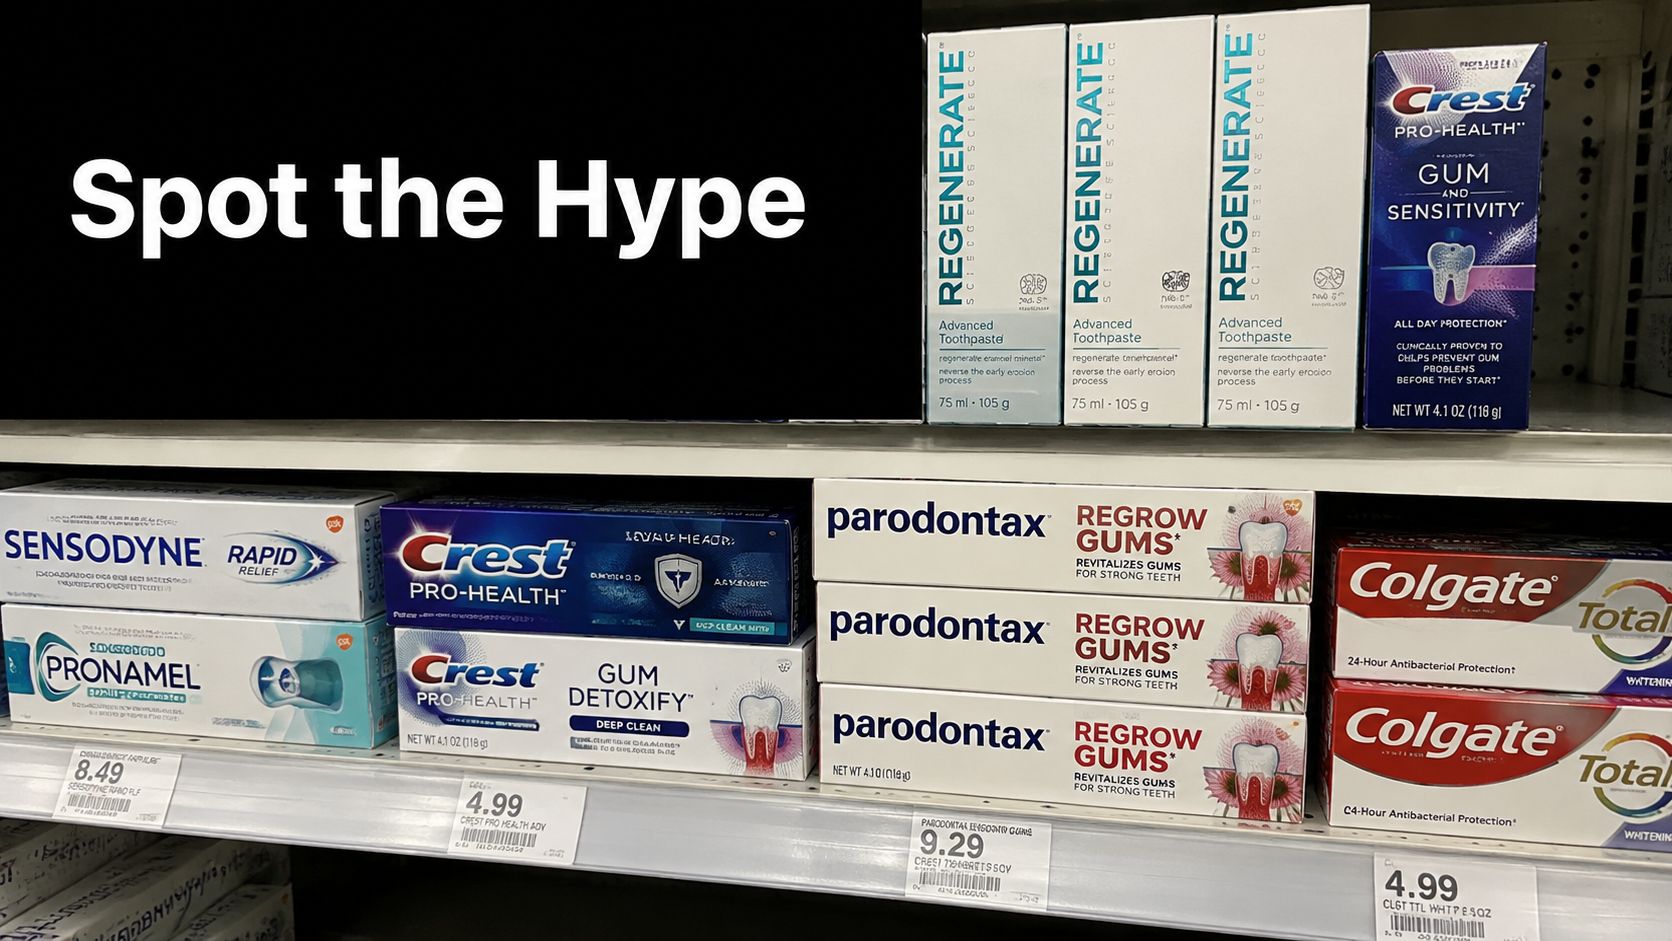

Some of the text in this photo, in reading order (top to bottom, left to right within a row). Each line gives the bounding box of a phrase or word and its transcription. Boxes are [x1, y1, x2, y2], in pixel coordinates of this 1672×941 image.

[1392, 83, 1530, 115] Crest
[1395, 122, 1516, 138] PRO-HEALTH
[1074, 42, 1103, 303] REGENERATE
[1219, 33, 1253, 301] REGENERATE
[1419, 162, 1489, 185] GUM
[939, 51, 964, 305] REGENERATE
[1442, 189, 1468, 198] AND
[1388, 202, 1517, 221] SENSITIVITY
[939, 320, 993, 330] Advanced
[1073, 319, 1133, 330] Advanced
[1219, 317, 1282, 328] Advanced
[1394, 320, 1414, 328] ALL
[1417, 320, 1438, 328] DAY
[1073, 332, 1142, 345] Toothpaste
[1219, 331, 1292, 344] Toothpaste
[1217, 378, 1256, 386] process
[1255, 368, 1270, 376] the
[1273, 368, 1296, 378] early
[1396, 376, 1435, 384] BEFORE
[1438, 376, 1463, 384] THEY
[939, 397, 1010, 411] 75 ml 105 g
[1072, 398, 1149, 412] 75 ml 105 g
[1218, 399, 1300, 413] 75 ml 105 g
[1392, 404, 1412, 417] NET
[1414, 404, 1431, 416] WT
[1433, 404, 1448, 417] 4.1
[1451, 405, 1465, 417] OZ
[828, 501, 1046, 538] parodontax
[1076, 505, 1208, 530] REGROW
[4, 529, 202, 567] SENSODYNE
[227, 545, 297, 567] RAPID
[401, 533, 571, 578] Crest
[238, 566, 279, 577] RELIEF
[1076, 558, 1182, 571] REVITALIZES GUMS
[1076, 569, 1181, 582] FOR STRONG TEETH
[410, 582, 560, 606] PRO-HEALTH
[1349, 561, 1553, 611] Colgate
[830, 607, 1045, 644] parodontax
[1075, 613, 1205, 640] REGROW
[1578, 601, 1672, 634] Total
[1347, 656, 1388, 668] 24-Hour
[46, 655, 201, 690] PRONAMEL
[411, 655, 540, 688] Crest
[598, 663, 658, 686] GUM
[1075, 665, 1178, 680] REVITALIZES GUMS
[1075, 675, 1178, 690] FOR STRONG TEETH
[416, 692, 532, 709] PRO-HEALTH
[569, 687, 688, 712] DETOXIFY
[596, 720, 661, 732] DEEP CLEAN
[833, 712, 1045, 751] parodontax
[1345, 707, 1557, 759] Colgate
[407, 734, 422, 744] NET
[425, 735, 437, 745] WT
[450, 737, 461, 746] OZ
[1075, 721, 1203, 750] REGROW
[74, 759, 124, 784] 8.49
[833, 765, 848, 776] NET
[850, 766, 862, 777] WT
[1074, 772, 1176, 788] REVITALIZES GUMS
[1578, 754, 1672, 788] Total
[1074, 783, 1176, 799] FOR STRONG TEETH
[466, 791, 523, 817] 4.99
[1389, 810, 1455, 822] Antibacterial
[920, 829, 984, 859] 9.29
[1385, 869, 1458, 902] 4.99
